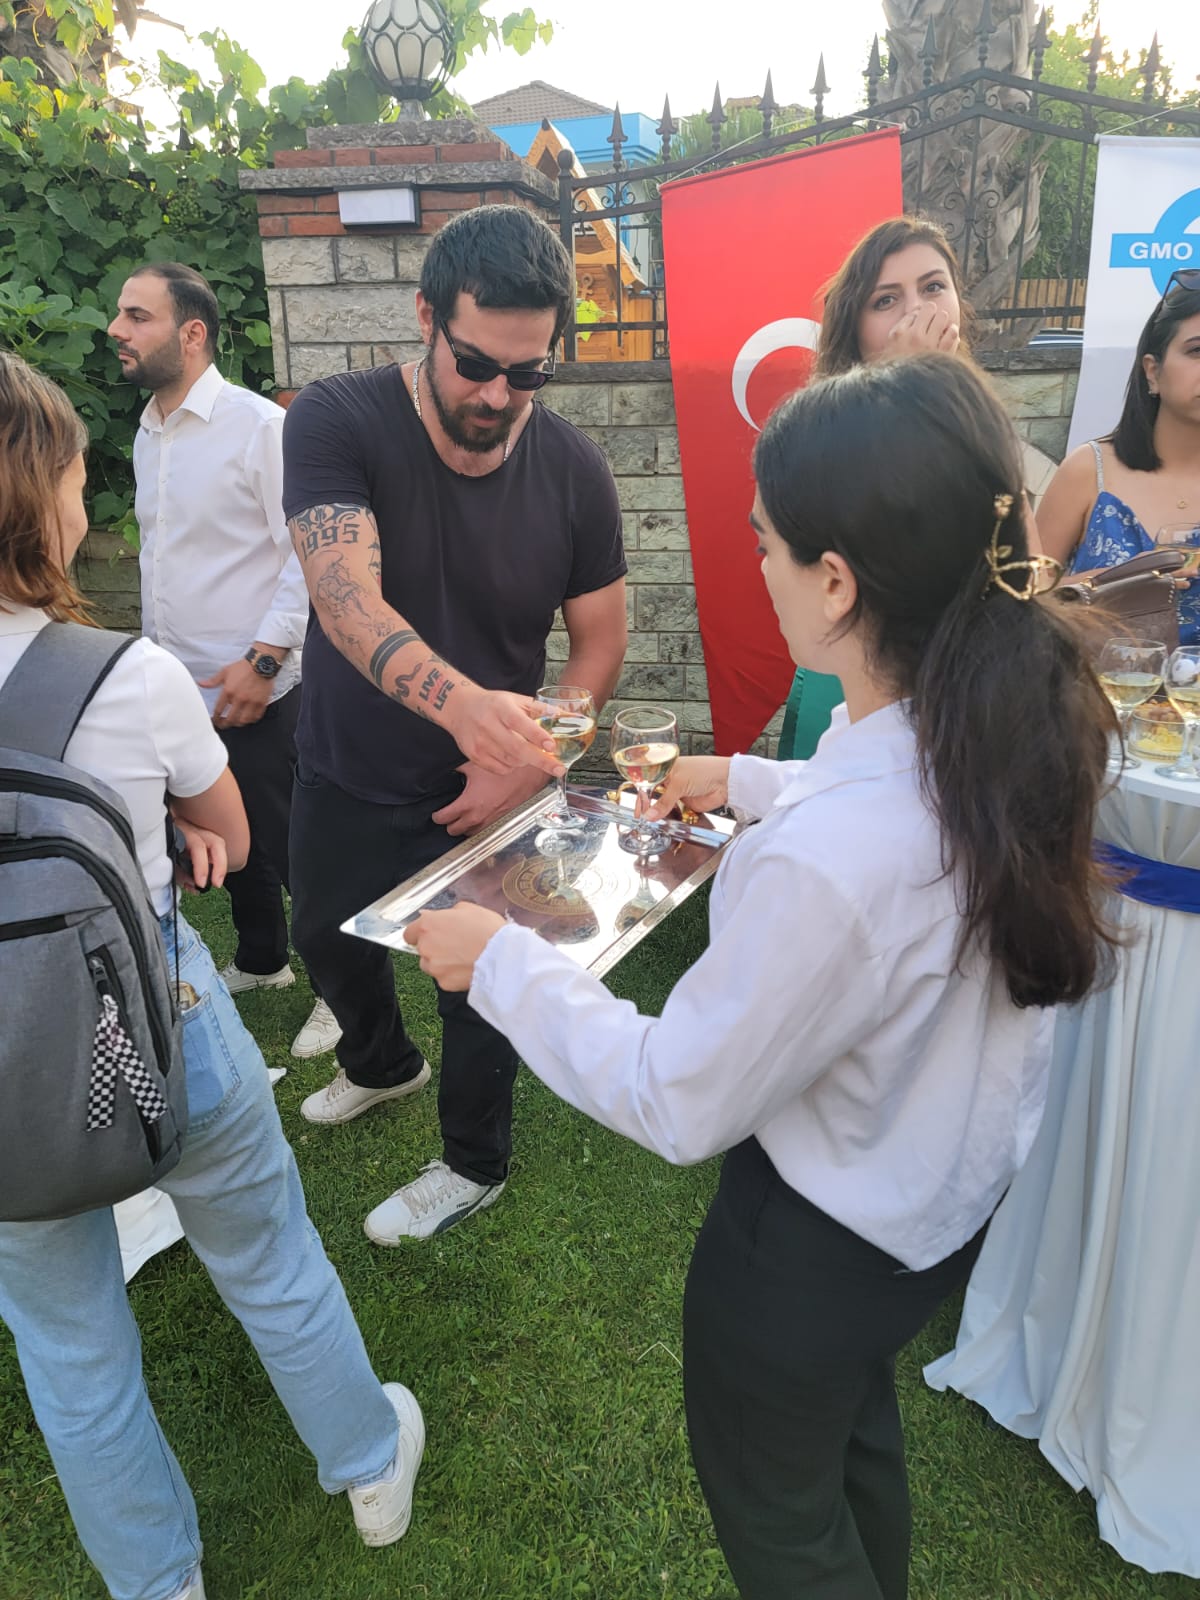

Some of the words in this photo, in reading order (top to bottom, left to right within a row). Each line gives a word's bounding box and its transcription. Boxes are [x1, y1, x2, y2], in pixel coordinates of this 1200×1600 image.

[1129, 241, 1193, 260] GMO
[301, 523, 360, 561] 1995
[418, 668, 440, 701] LIVE
[433, 679, 455, 711] LIFE
